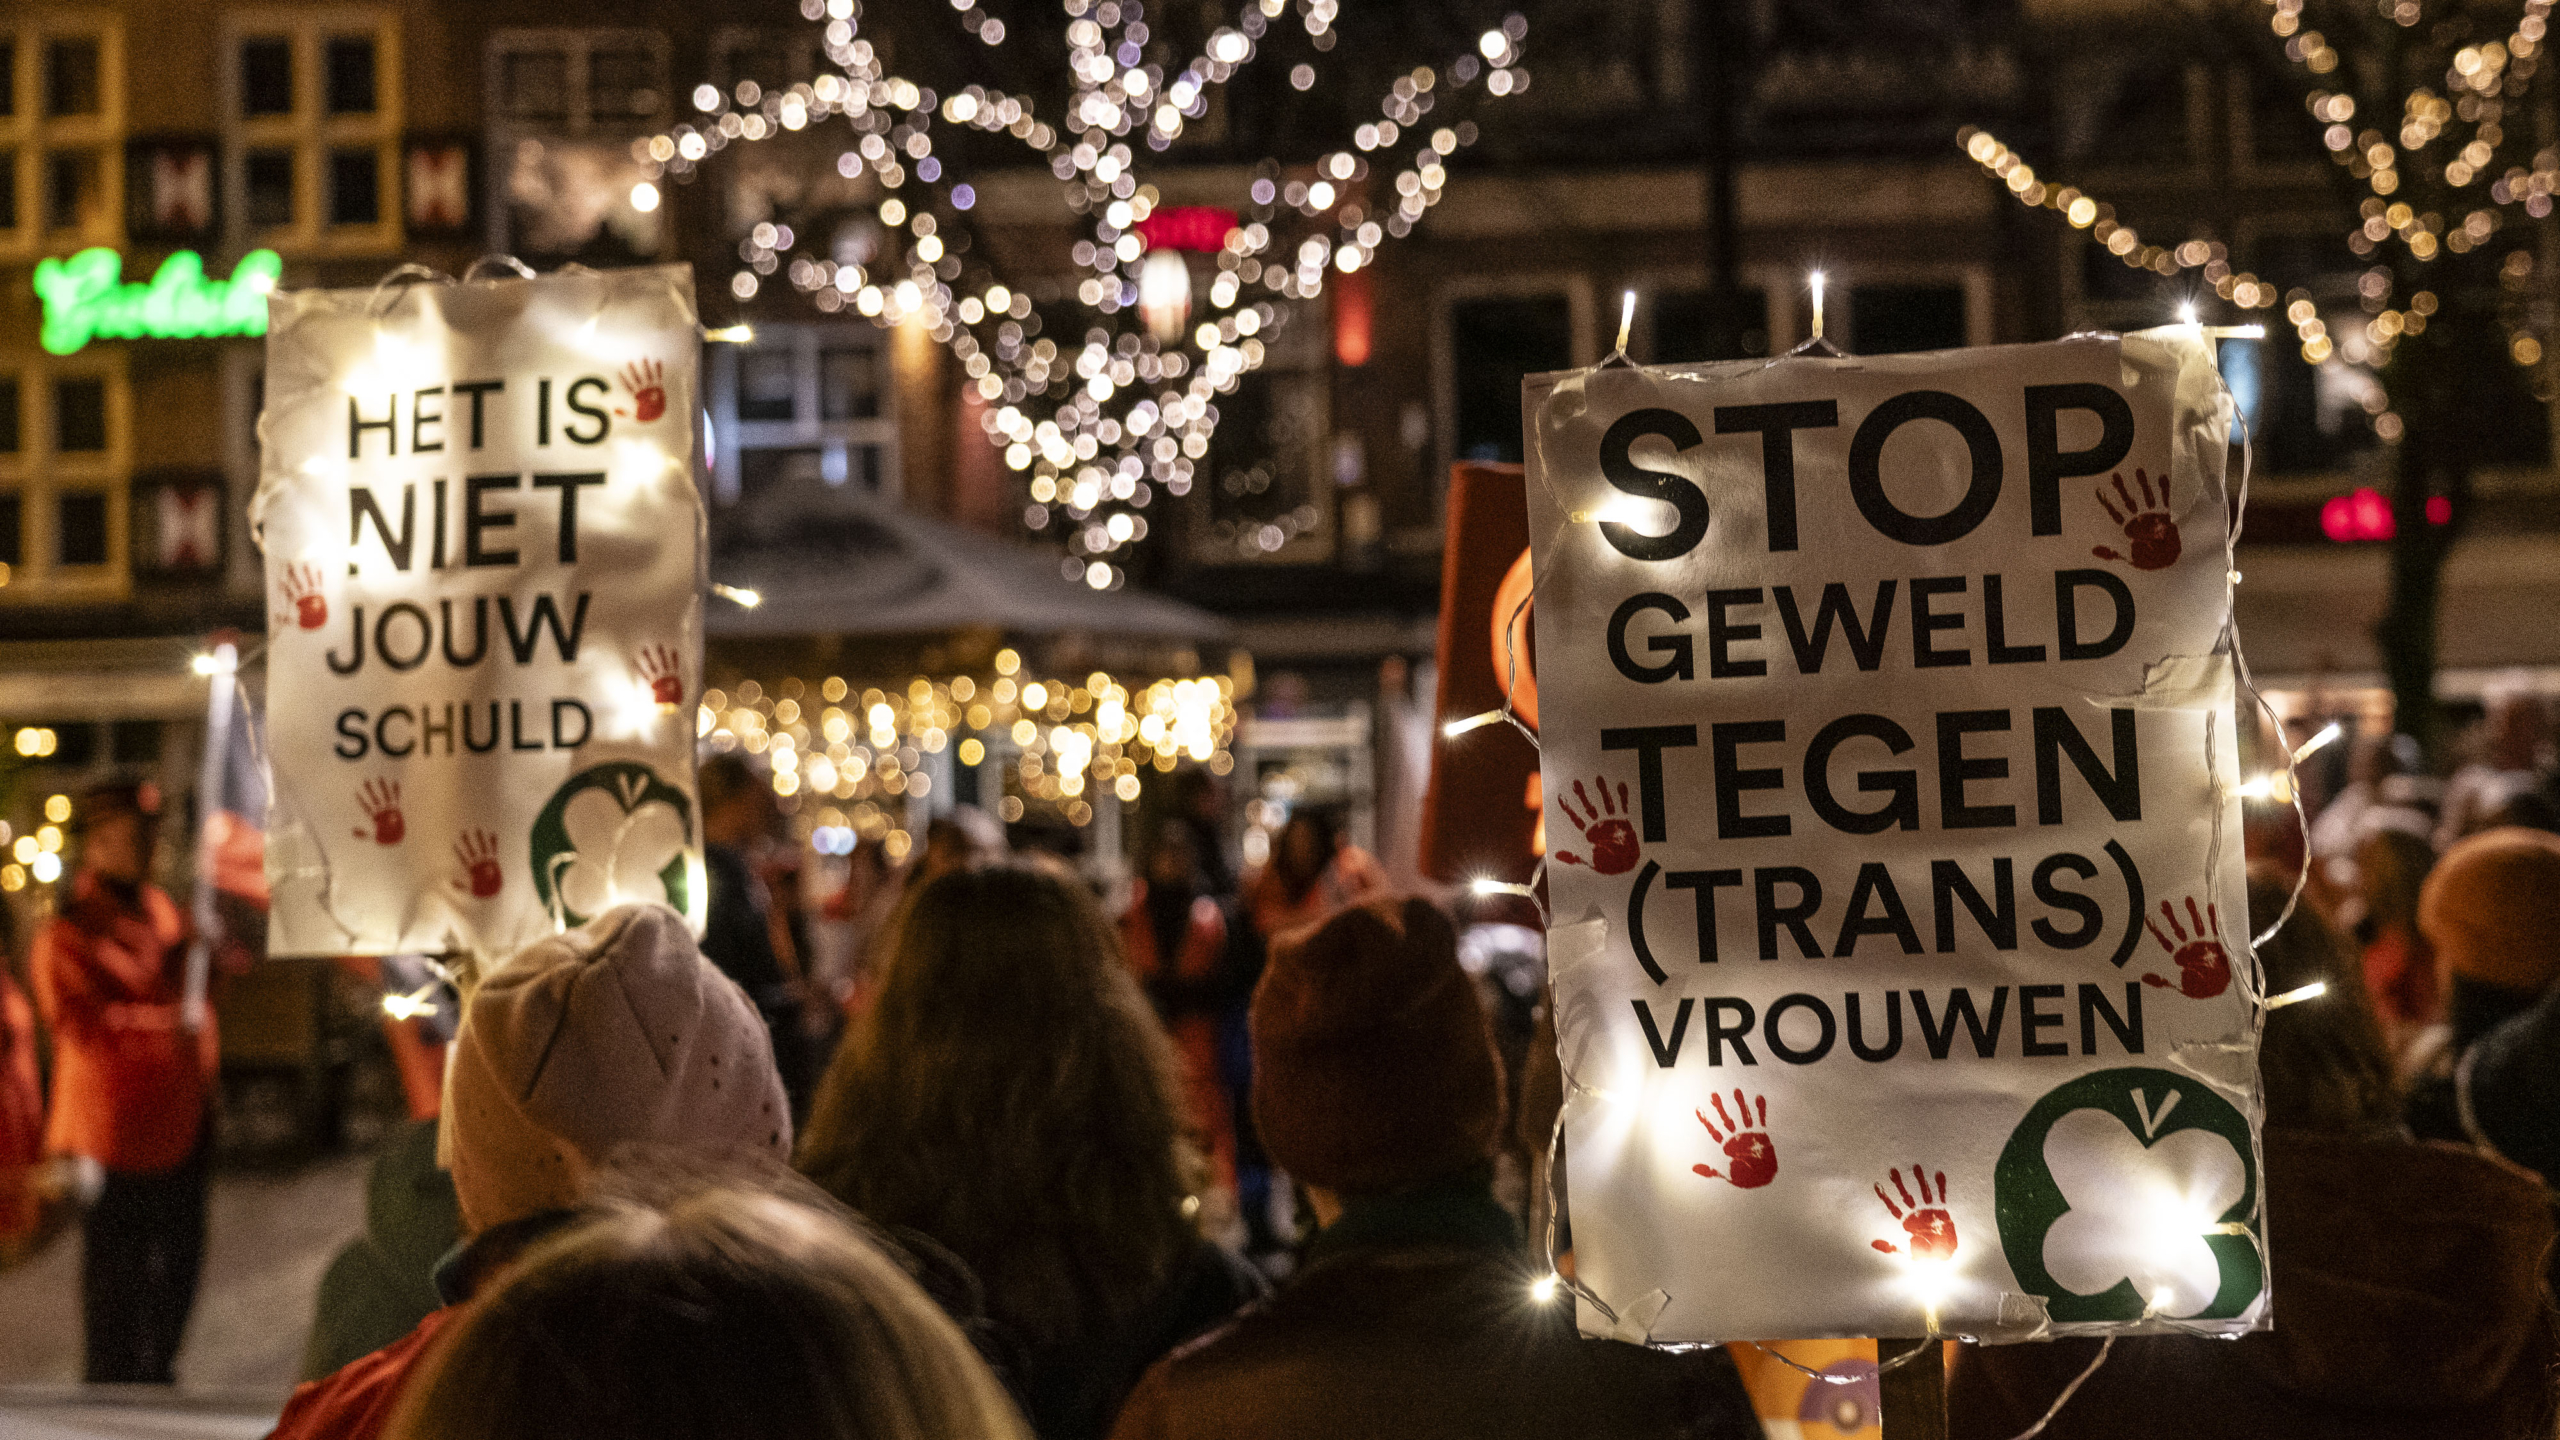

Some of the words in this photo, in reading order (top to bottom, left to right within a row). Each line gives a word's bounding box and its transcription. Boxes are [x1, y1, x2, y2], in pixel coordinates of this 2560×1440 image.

[349, 379, 504, 458] HET
[537, 377, 611, 446] IS
[349, 472, 606, 575] NIET
[1599, 382, 2134, 562] STOP
[326, 593, 592, 675] JOUW
[1607, 568, 2135, 684] GEWELD
[334, 699, 593, 759] SCHULD
[1601, 706, 2142, 843] TEGEN
[1627, 838, 2145, 986] (TRANS)
[1631, 981, 2145, 1068] VROUWEN
